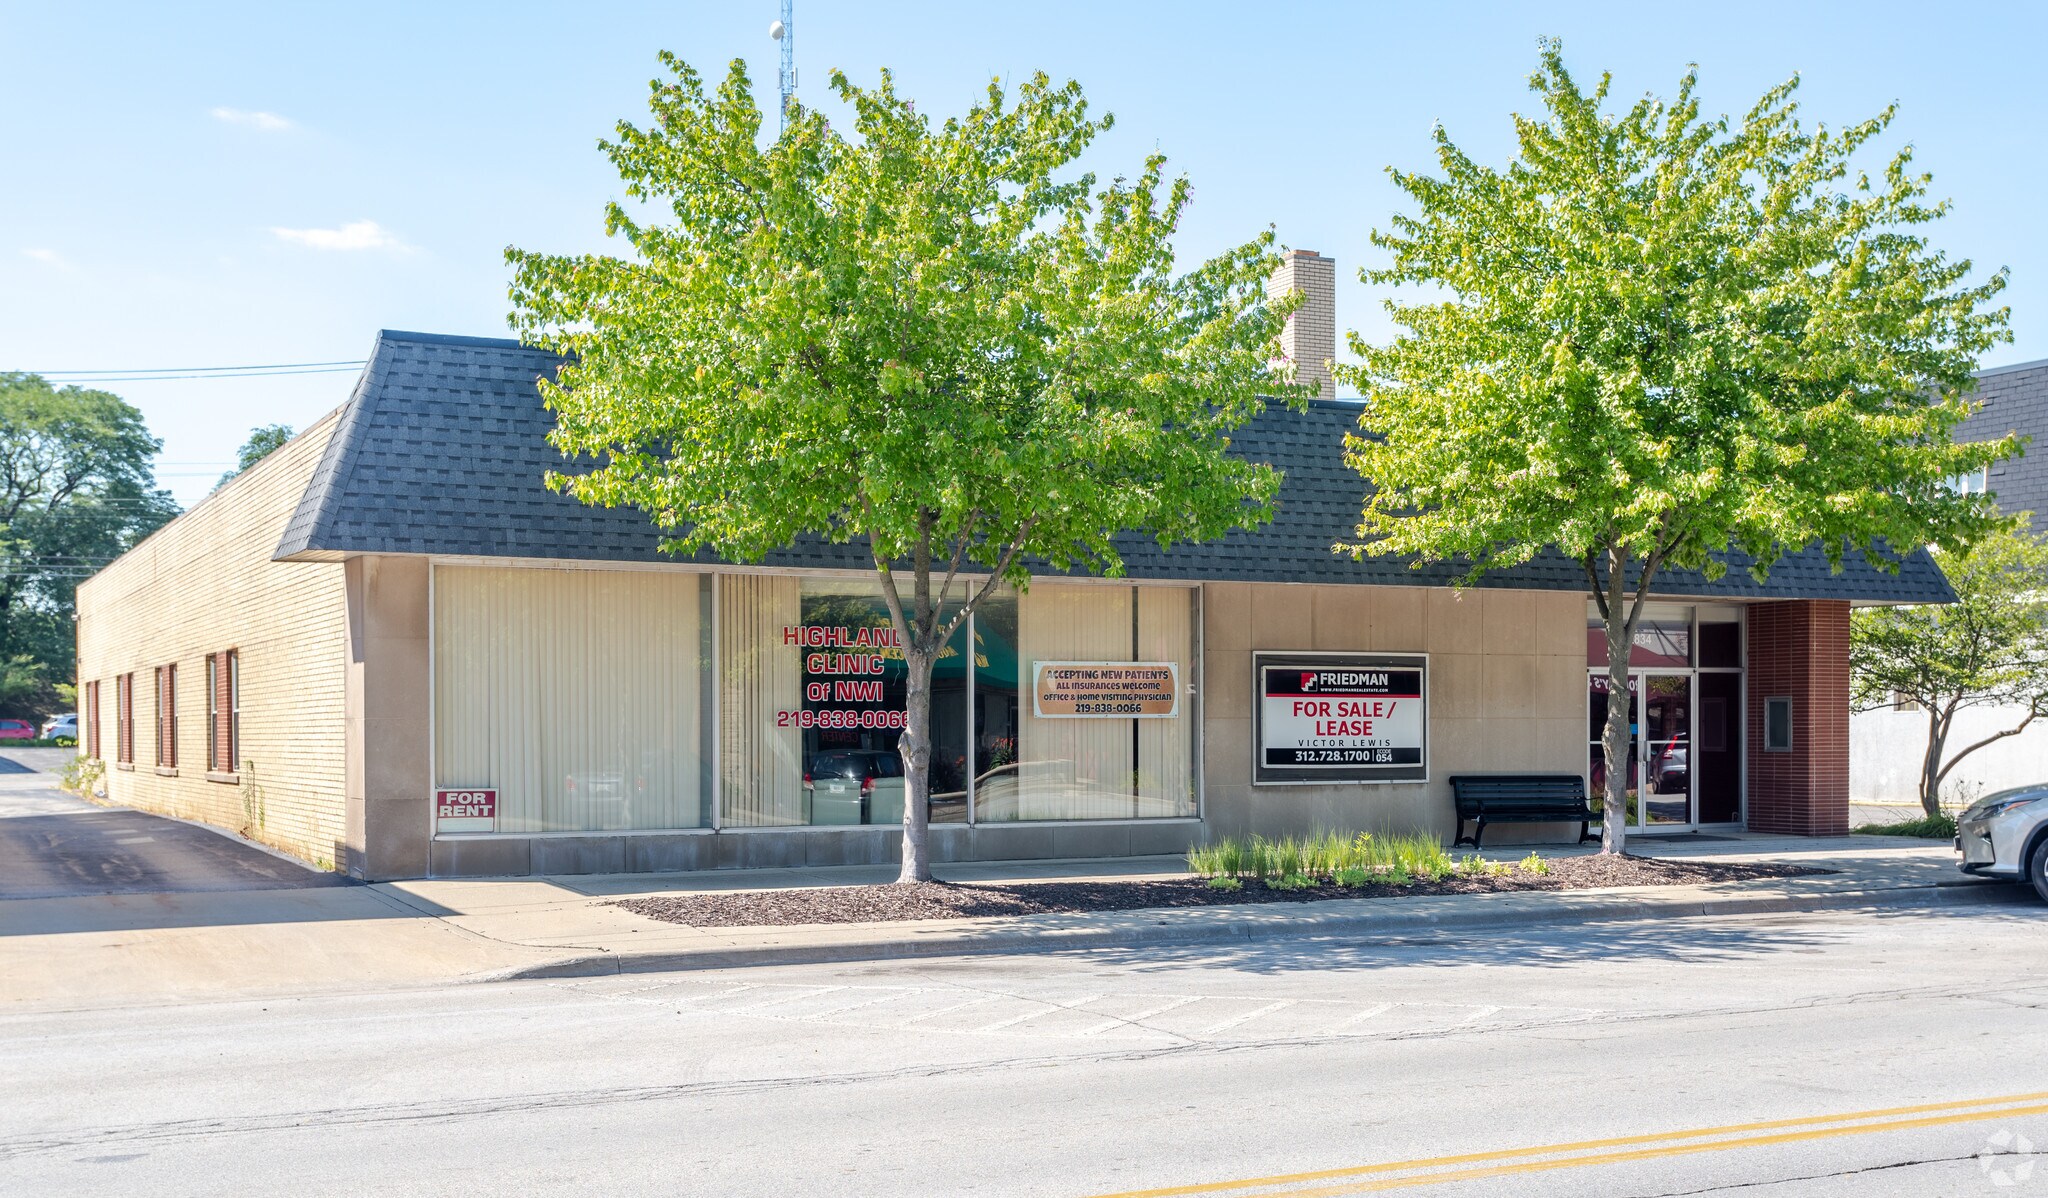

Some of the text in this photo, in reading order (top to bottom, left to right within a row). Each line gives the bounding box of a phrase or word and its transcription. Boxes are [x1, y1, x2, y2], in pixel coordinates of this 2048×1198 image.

[807, 653, 885, 675] CLINIC
[1047, 670, 1169, 679] ACCEPTING NEW PATIENTS
[1320, 673, 1388, 686] FRIEDMAN
[835, 681, 883, 701] NWI
[1056, 682, 1070, 690] ALL
[1075, 703, 1142, 713] 219-838-0066
[1293, 701, 1331, 717] FOR
[1316, 720, 1373, 736] LEASE
[1298, 739, 1391, 747] VICTOR LEWIS
[1295, 750, 1370, 762] 312.728.1700
[1376, 753, 1392, 762] 054
[446, 792, 486, 804] FOR
[439, 805, 493, 817] RENT
